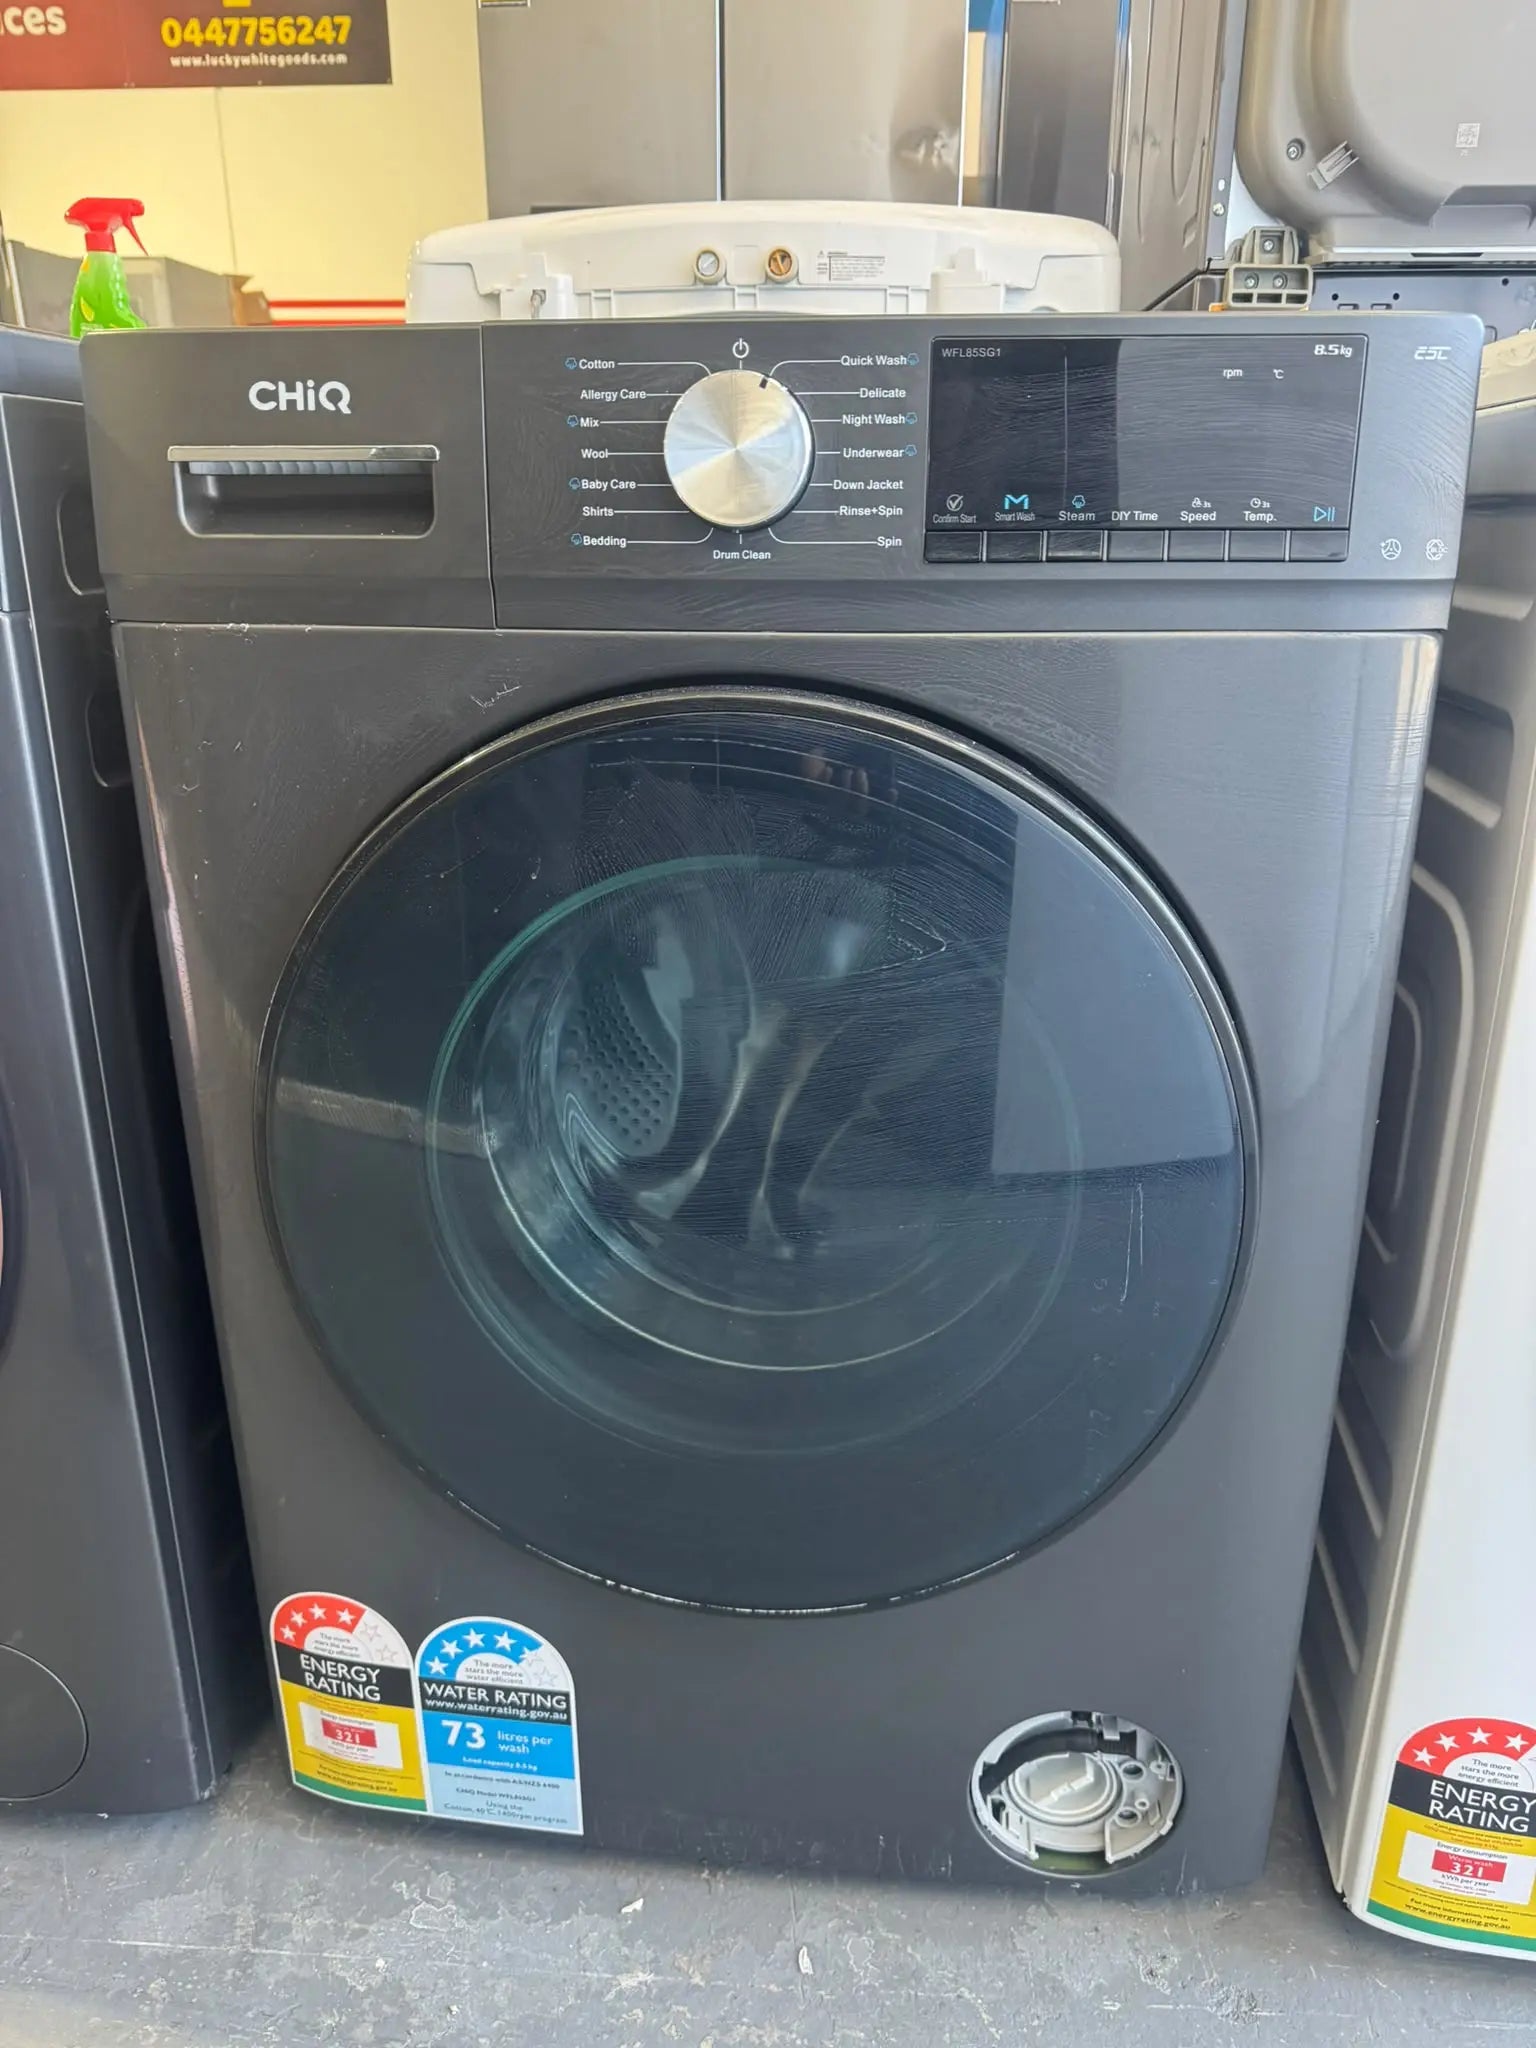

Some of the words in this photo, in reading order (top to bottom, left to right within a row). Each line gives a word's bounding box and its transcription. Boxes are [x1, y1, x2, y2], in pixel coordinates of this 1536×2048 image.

[160, 15, 351, 48] 0447756247
[169, 52, 348, 68] www.luckywhitegoods.com
[942, 347, 1001, 358] WFL85SG1
[1314, 344, 1339, 355] 8.5
[1340, 345, 1352, 357] kg
[579, 358, 615, 370] Cotton
[841, 355, 874, 366] Quick
[875, 355, 907, 366] Wash
[1223, 368, 1243, 379] rpm
[248, 379, 352, 414] CHiQ
[580, 389, 618, 402] Allergy
[620, 388, 647, 399] Care
[860, 387, 906, 398] Delicate
[580, 417, 600, 428] Mix
[842, 414, 873, 427] Night
[874, 413, 906, 424] Wash
[581, 448, 608, 459] Wool
[843, 447, 905, 458] Underwear
[581, 479, 609, 491] Baby
[610, 479, 637, 489] Care
[833, 479, 865, 490] Down
[866, 479, 904, 490] Jacket
[582, 506, 614, 517] Shirts
[839, 505, 903, 517] Rinse+Spin
[995, 511, 1016, 522] Smart
[1016, 511, 1036, 522] Wash
[1058, 510, 1096, 521] Steam
[1111, 511, 1131, 521] DIY
[1133, 511, 1159, 521] Time
[1180, 511, 1217, 523] Speed
[1243, 511, 1277, 523] Temp.
[932, 513, 959, 524] Confirm
[960, 513, 977, 524] Start
[583, 536, 627, 548] Bedding
[877, 536, 903, 548] Spin
[713, 549, 740, 560] Drum
[742, 549, 771, 560] Clean
[300, 1653, 380, 1683] ENERGY
[304, 1671, 381, 1701] RATING
[423, 1681, 490, 1702] WATER
[494, 1689, 567, 1710] RATING
[425, 1699, 568, 1720] www.waterrating.gov.au
[335, 1729, 361, 1744] 321
[441, 1719, 486, 1750] 73
[497, 1730, 529, 1743] litres
[532, 1735, 553, 1747] per
[498, 1743, 530, 1755] wash
[1472, 1758, 1488, 1768] The
[1490, 1763, 1512, 1771] more
[1461, 1765, 1481, 1774] stars
[1482, 1768, 1496, 1777] the
[1497, 1771, 1519, 1780] more
[1458, 1772, 1485, 1783] energy
[1487, 1777, 1519, 1788] efficient
[1430, 1779, 1536, 1814] ENERGY
[1429, 1799, 1530, 1833] RATING
[1437, 1841, 1461, 1853] Energy
[1462, 1848, 1508, 1860] consumption
[1450, 1861, 1484, 1878] 321
